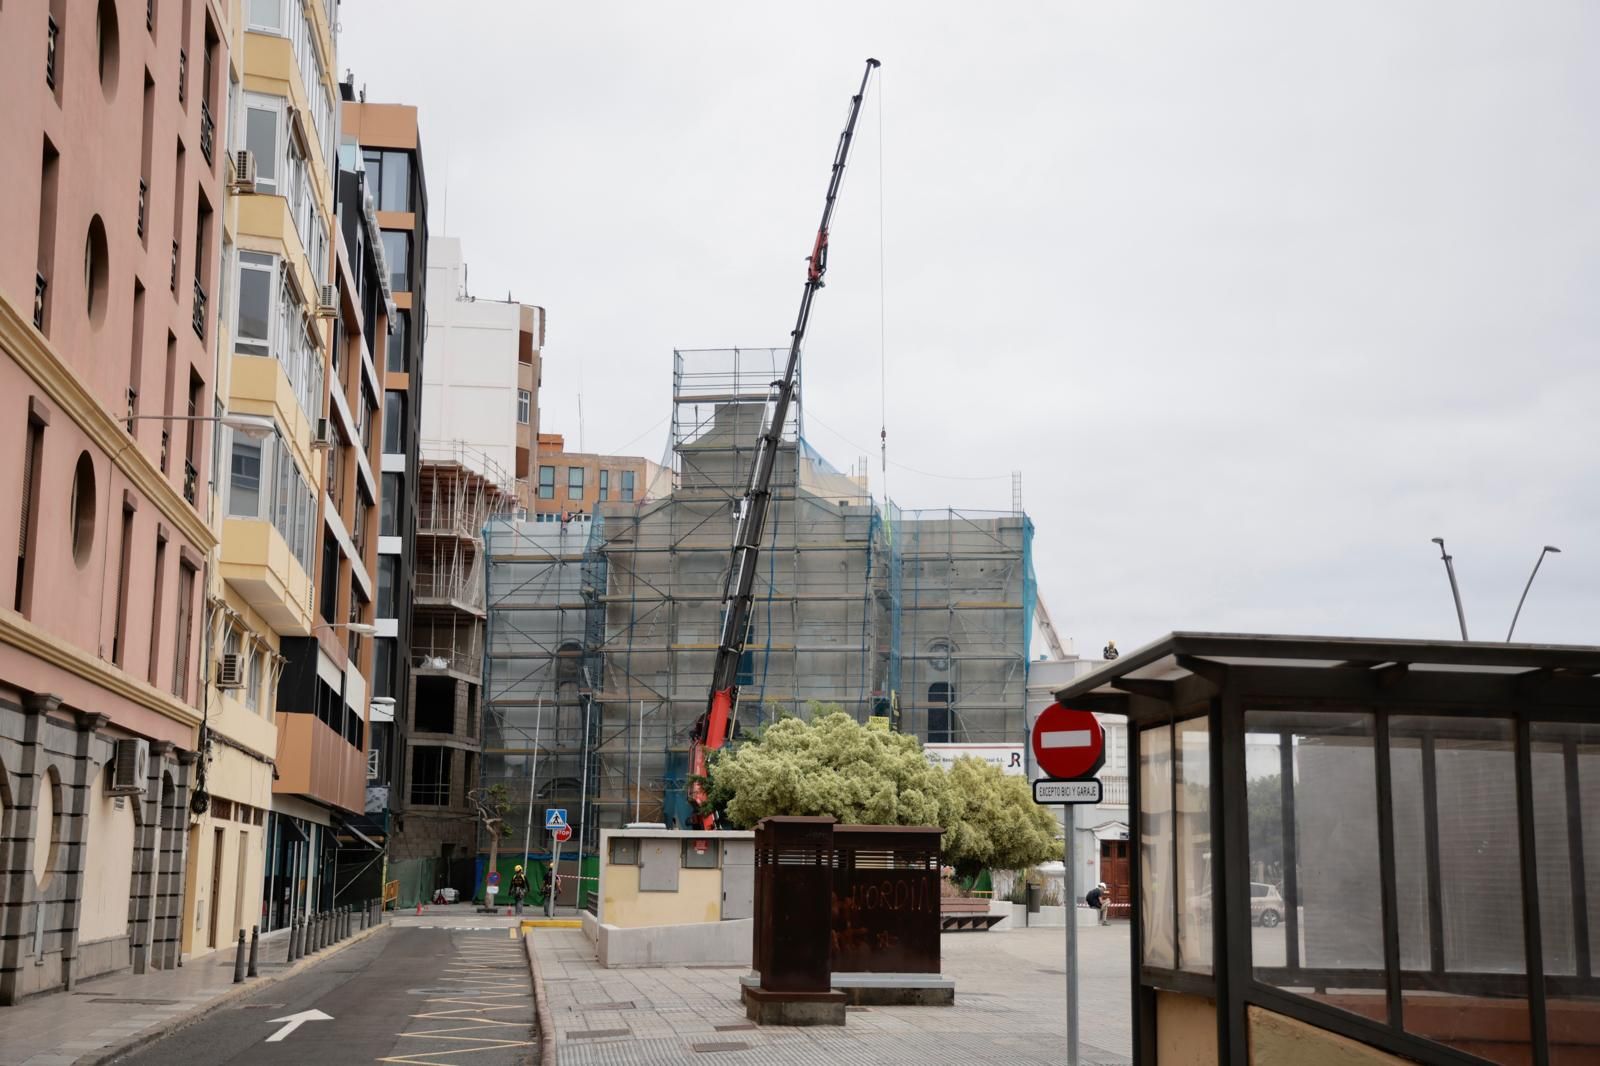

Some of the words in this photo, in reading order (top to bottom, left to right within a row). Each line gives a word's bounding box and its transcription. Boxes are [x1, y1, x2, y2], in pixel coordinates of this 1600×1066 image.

[1008, 752, 1020, 767] JR
[1040, 786, 1060, 796] EXCEPTO
[1061, 786, 1071, 796] BICI
[1072, 786, 1076, 796] Y
[1077, 786, 1096, 796] GARAJE
